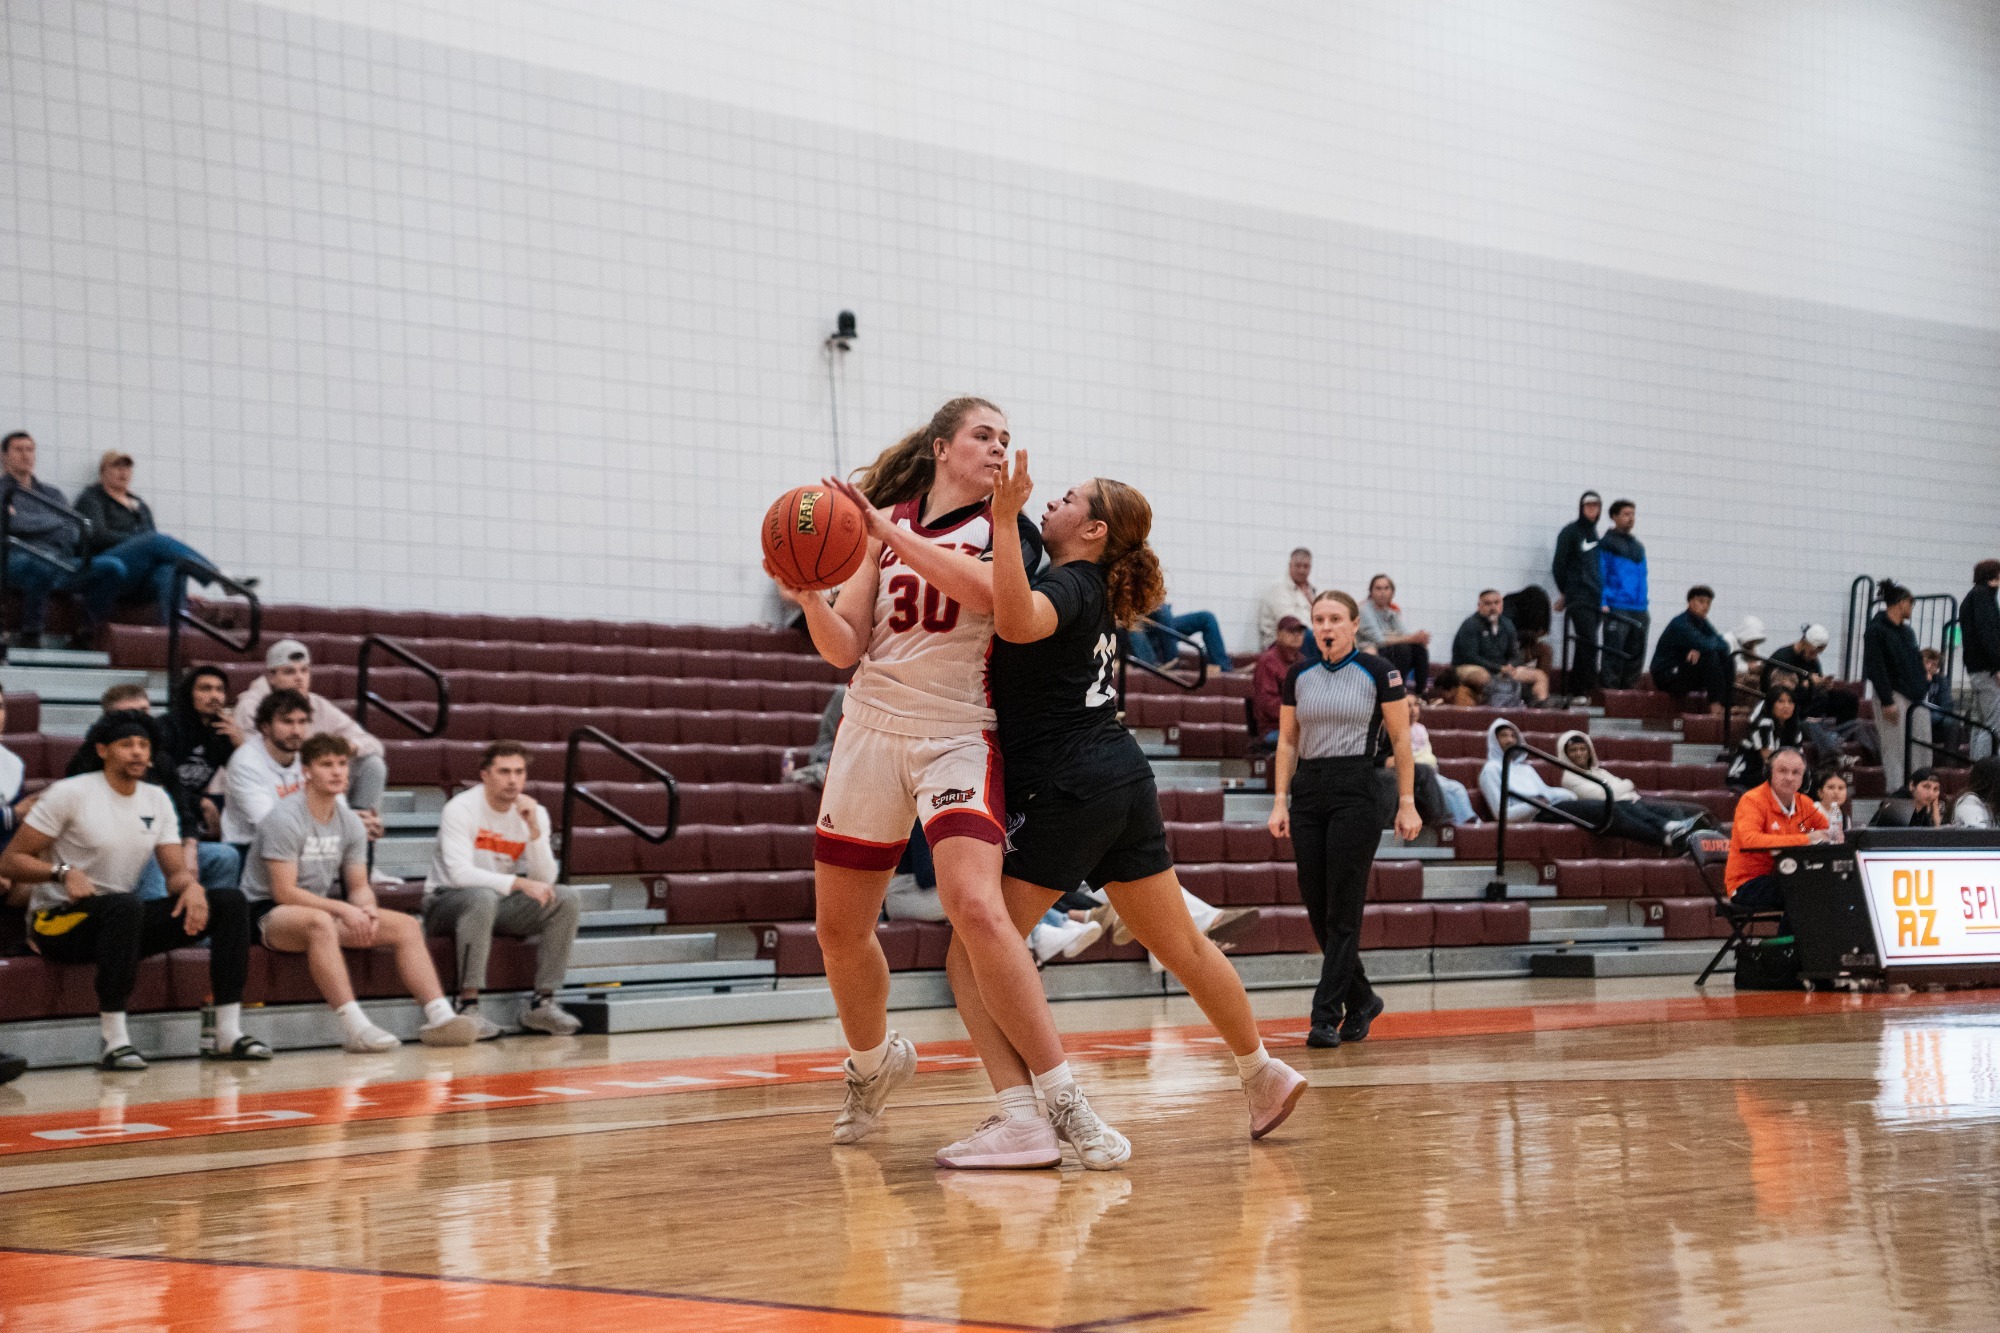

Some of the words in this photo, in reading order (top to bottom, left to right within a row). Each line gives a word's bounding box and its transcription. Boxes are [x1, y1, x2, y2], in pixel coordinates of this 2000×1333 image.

[798, 492, 820, 533] NAIA
[888, 573, 960, 634] 30
[934, 792, 968, 808] SPIRIT
[1892, 869, 1934, 905] OU
[1896, 909, 1940, 946] AZ
